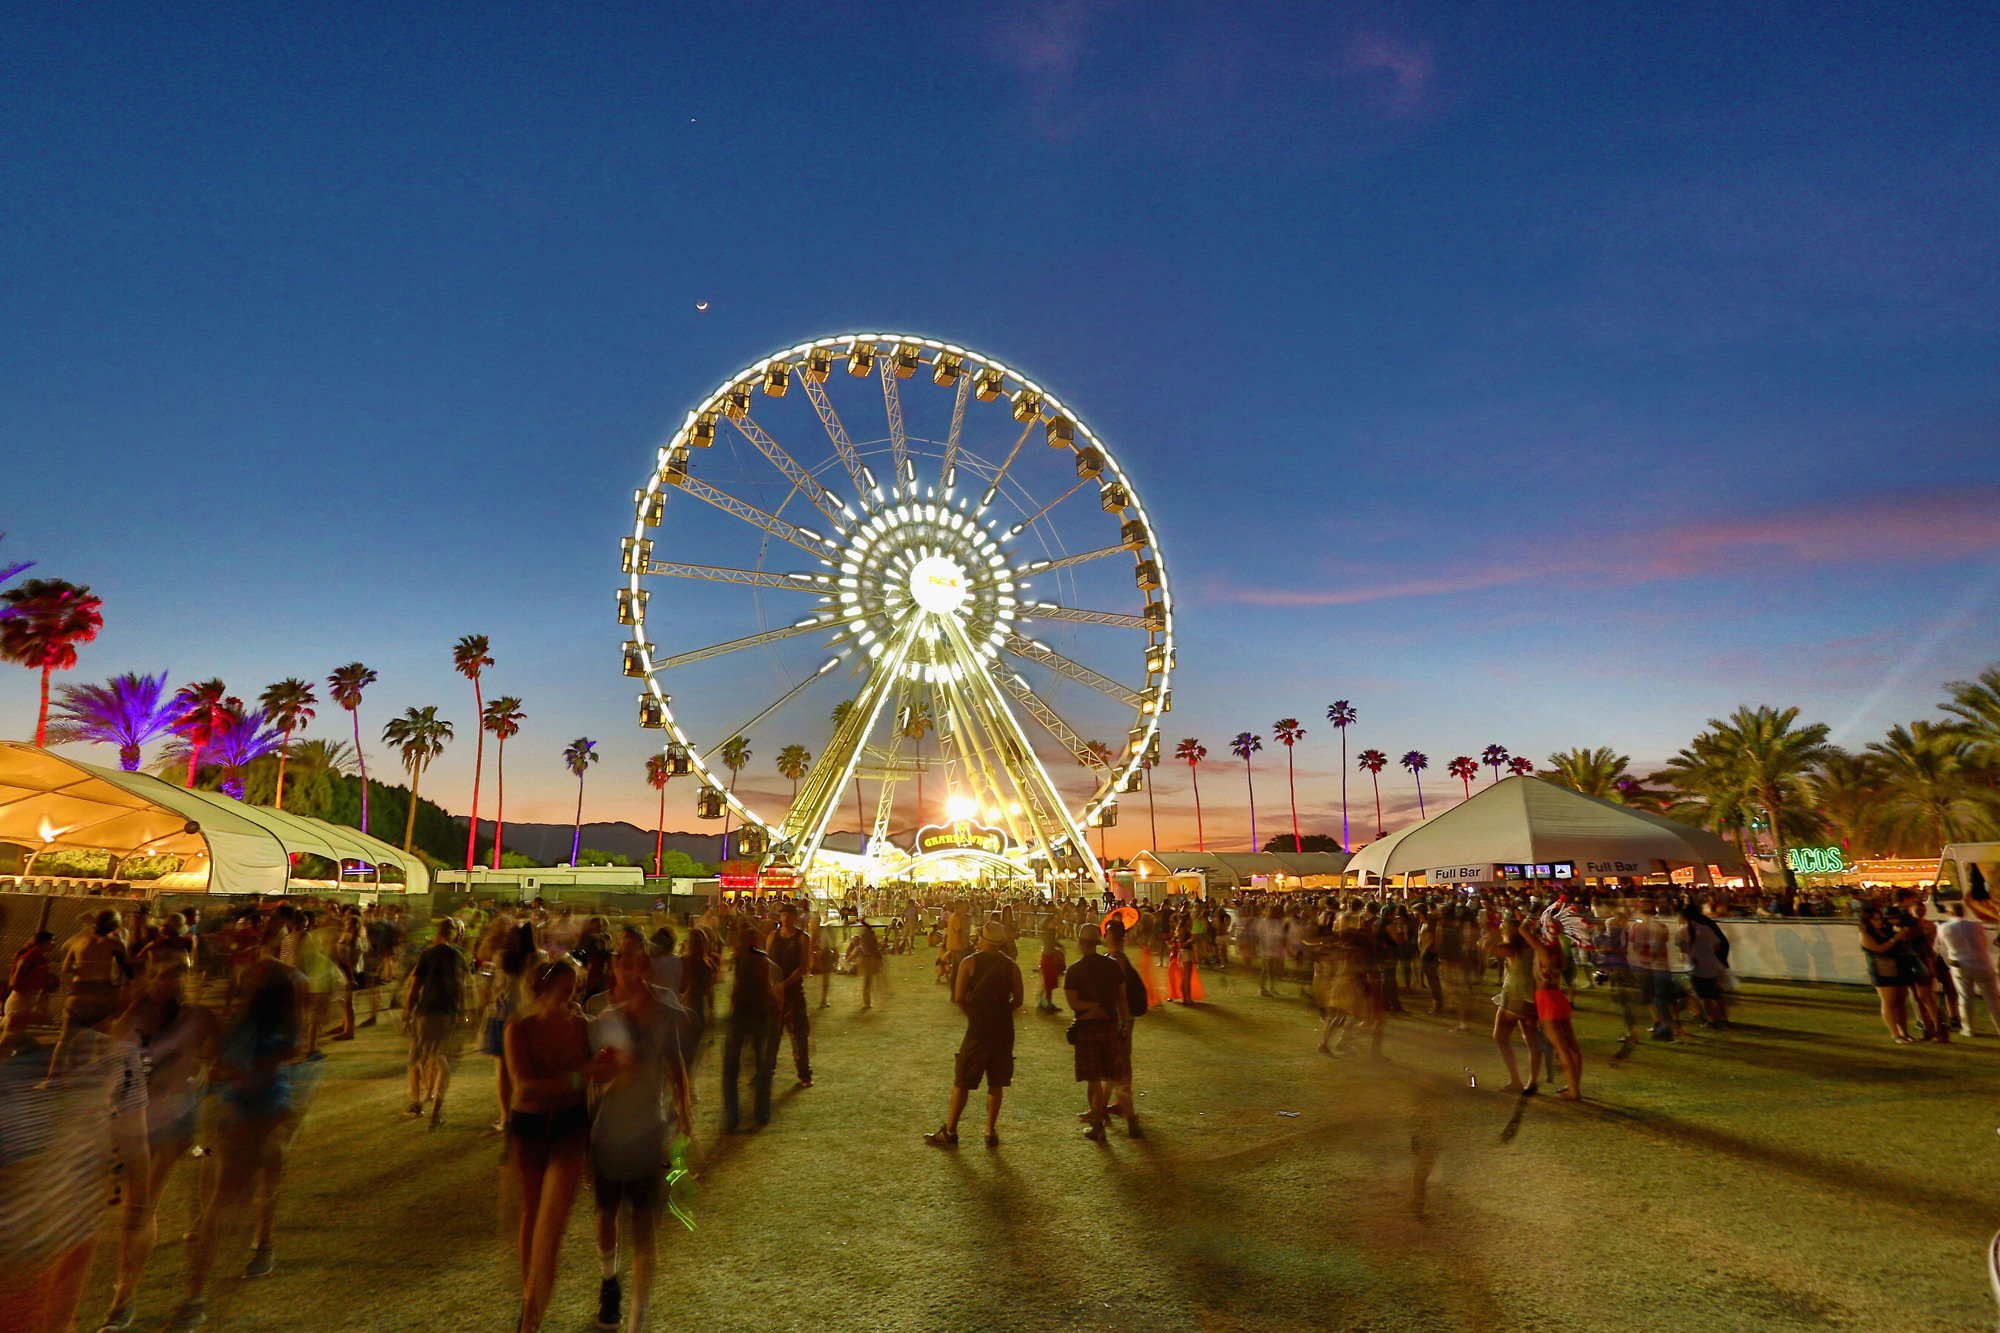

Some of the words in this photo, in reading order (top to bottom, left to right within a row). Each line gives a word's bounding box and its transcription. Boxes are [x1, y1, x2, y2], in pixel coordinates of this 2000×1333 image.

[1587, 861, 1612, 872] Full
[1614, 861, 1638, 872] Bar
[1435, 869, 1456, 879] Full
[1459, 867, 1481, 878] Bar
